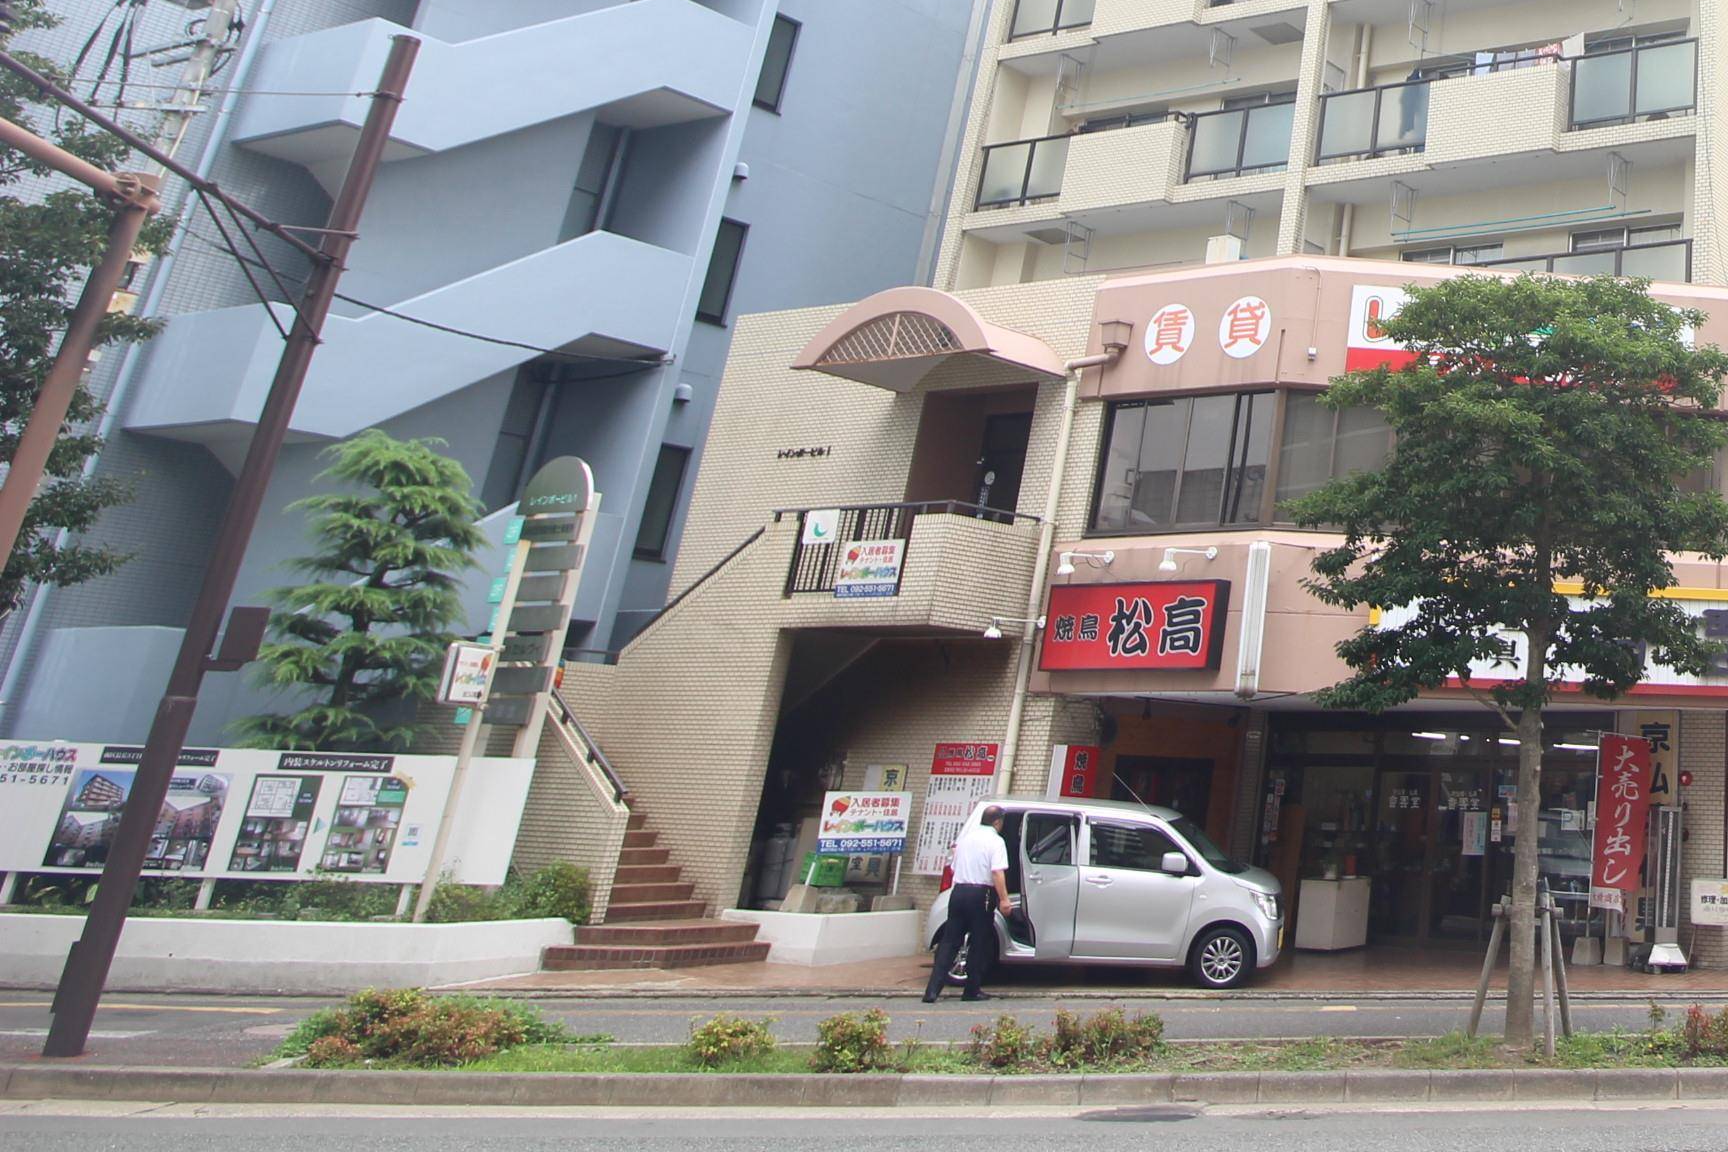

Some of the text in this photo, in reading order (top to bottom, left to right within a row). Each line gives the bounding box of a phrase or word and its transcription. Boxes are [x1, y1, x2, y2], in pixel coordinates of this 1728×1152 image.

[1149, 300, 1268, 355] 賃貸
[1053, 595, 1207, 657] 焼鳥 松高
[823, 819, 904, 833] レインボーハウス
[1603, 744, 1641, 885] 大売り出し
[820, 839, 838, 848] TEL
